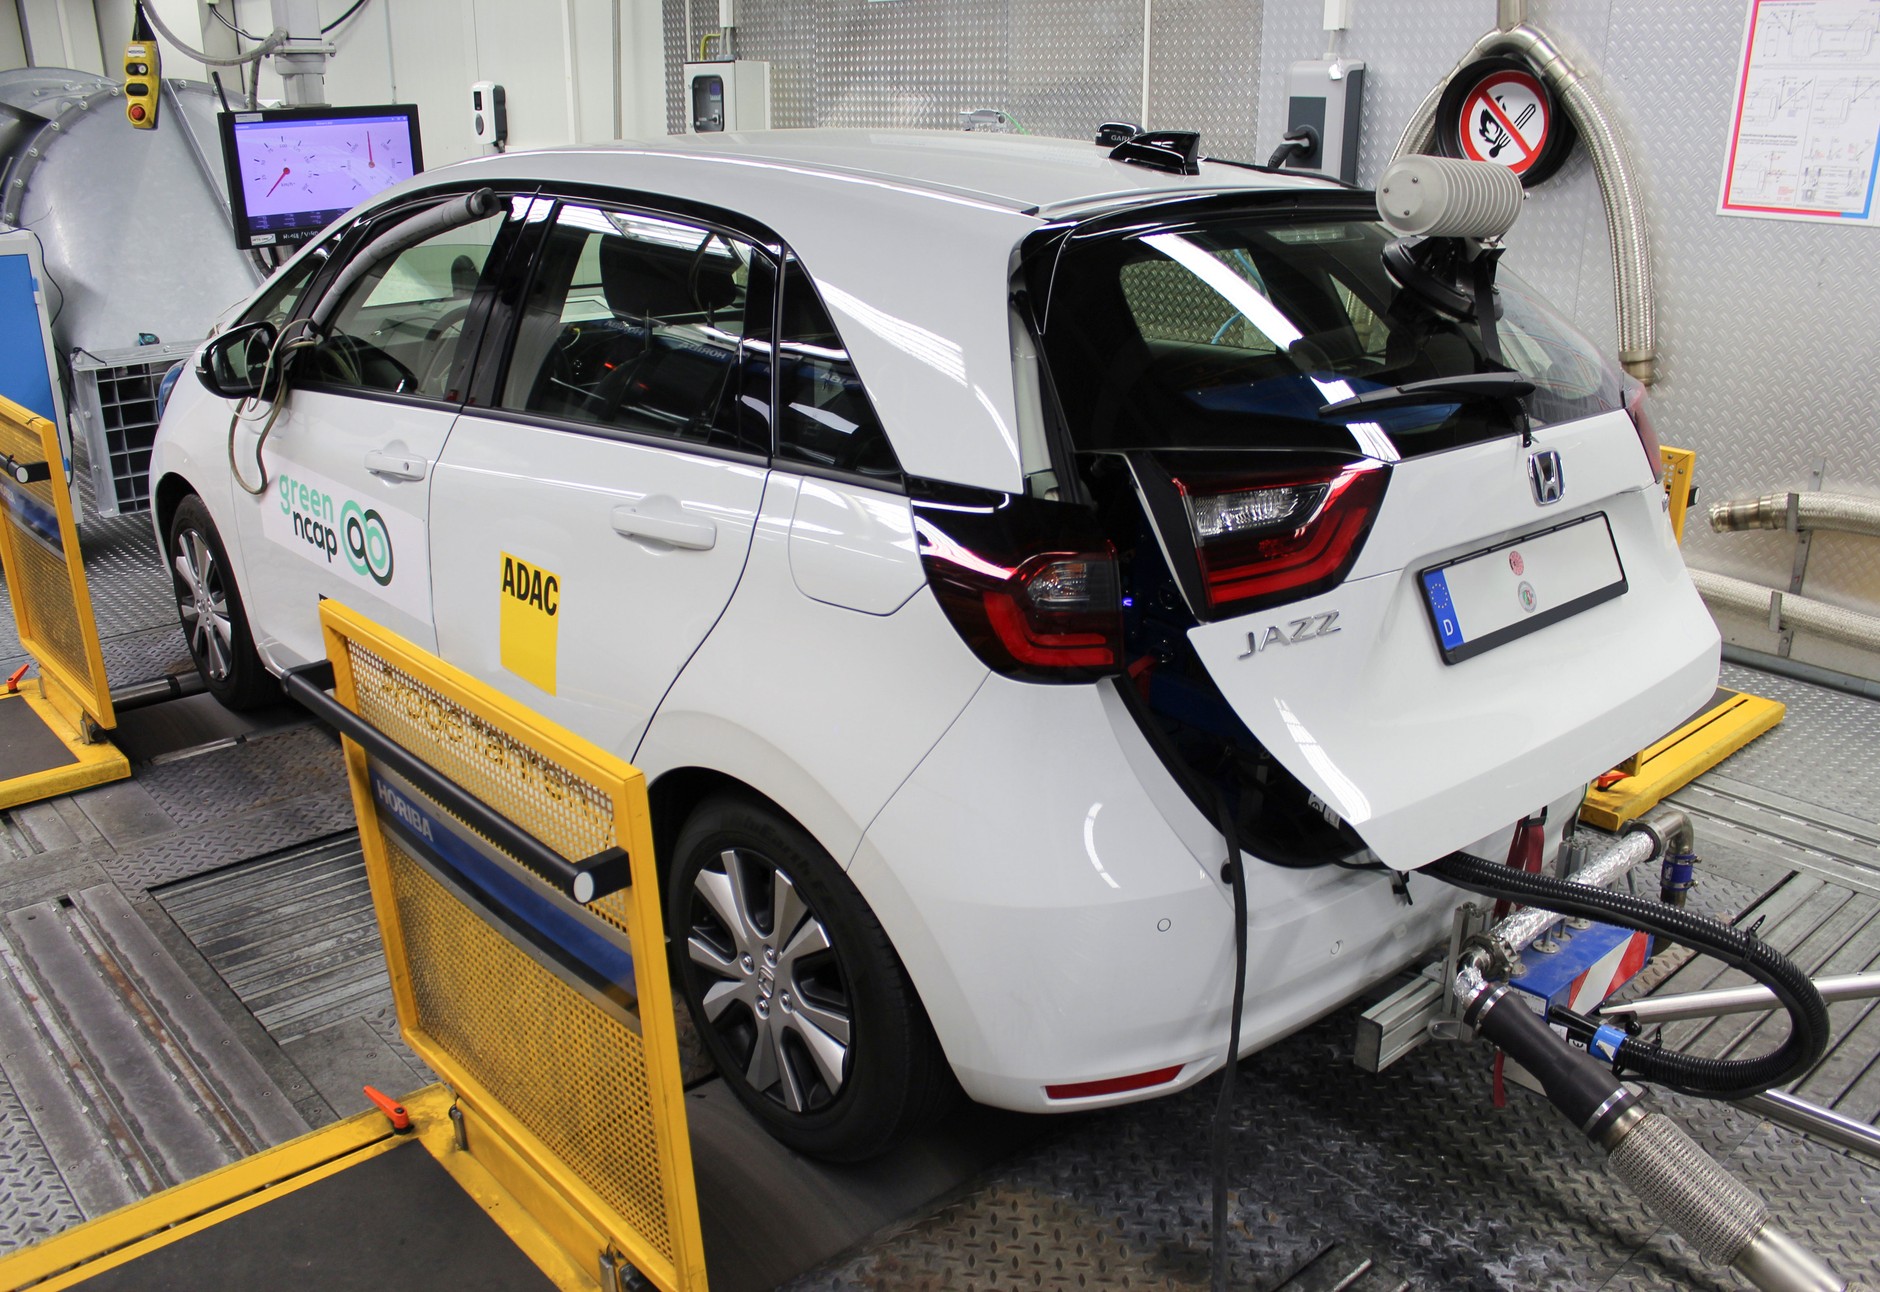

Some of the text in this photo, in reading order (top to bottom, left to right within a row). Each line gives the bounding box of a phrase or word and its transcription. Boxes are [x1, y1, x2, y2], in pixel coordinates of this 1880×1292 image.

[279, 474, 334, 524] green
[293, 511, 338, 563] ncap
[502, 556, 558, 616] ADAC
[1238, 609, 1341, 660] JAZZ
[1443, 619, 1454, 636] D
[377, 779, 434, 843] HORIBA
